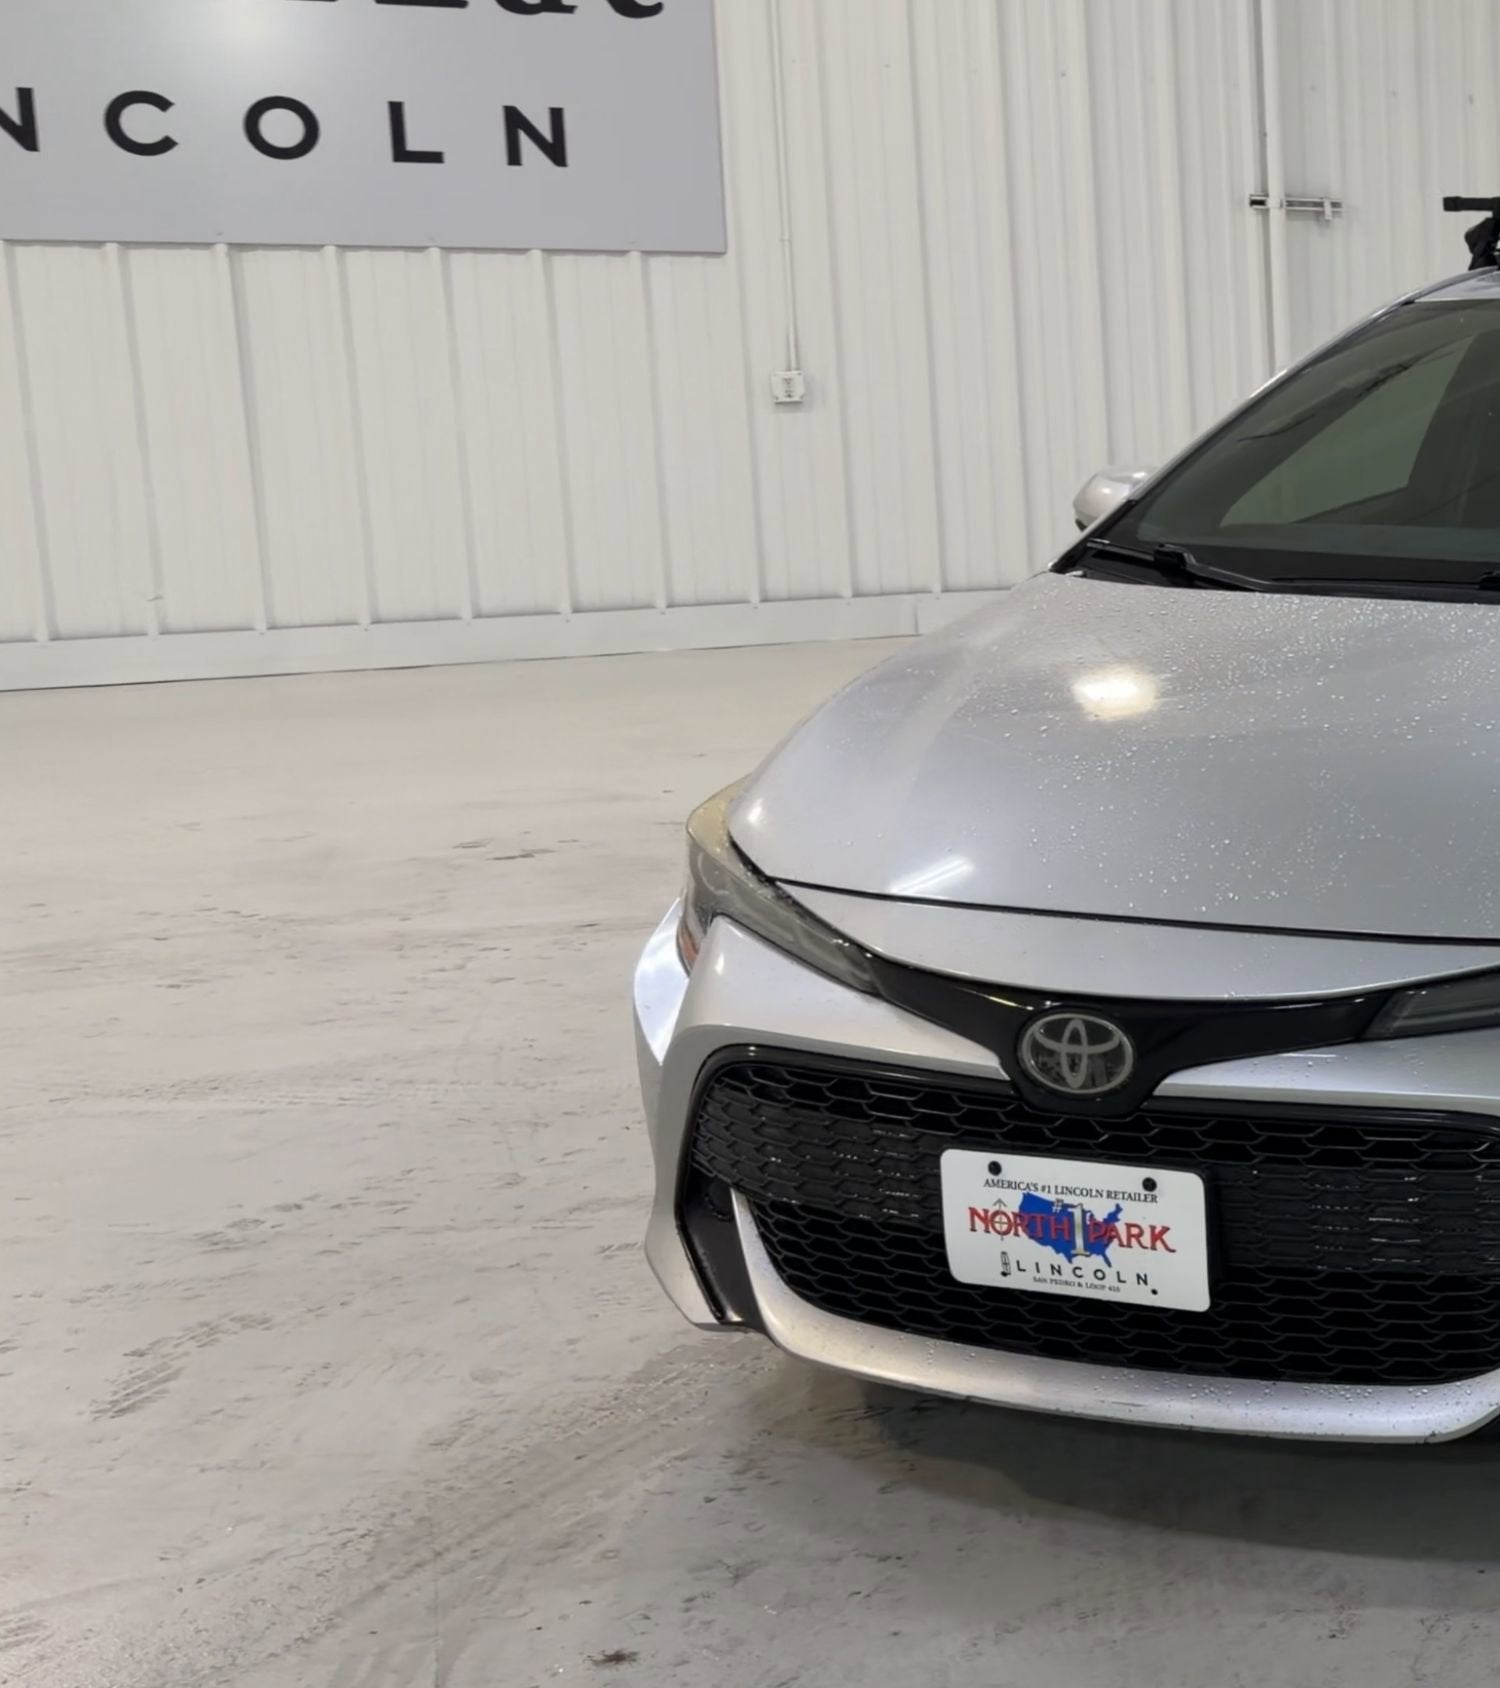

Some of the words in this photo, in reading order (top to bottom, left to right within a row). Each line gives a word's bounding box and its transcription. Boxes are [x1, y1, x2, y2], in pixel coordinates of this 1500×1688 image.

[984, 1179, 1039, 1192] AMERICA'S
[1040, 1185, 1052, 1194] #1
[1053, 1186, 1105, 1198] LINCOLN
[1106, 1190, 1158, 1203] RETAILER
[968, 1207, 1071, 1240] NORTH
[1088, 1219, 1176, 1253] PARK
[1017, 1261, 1149, 1286] LINCOLN
